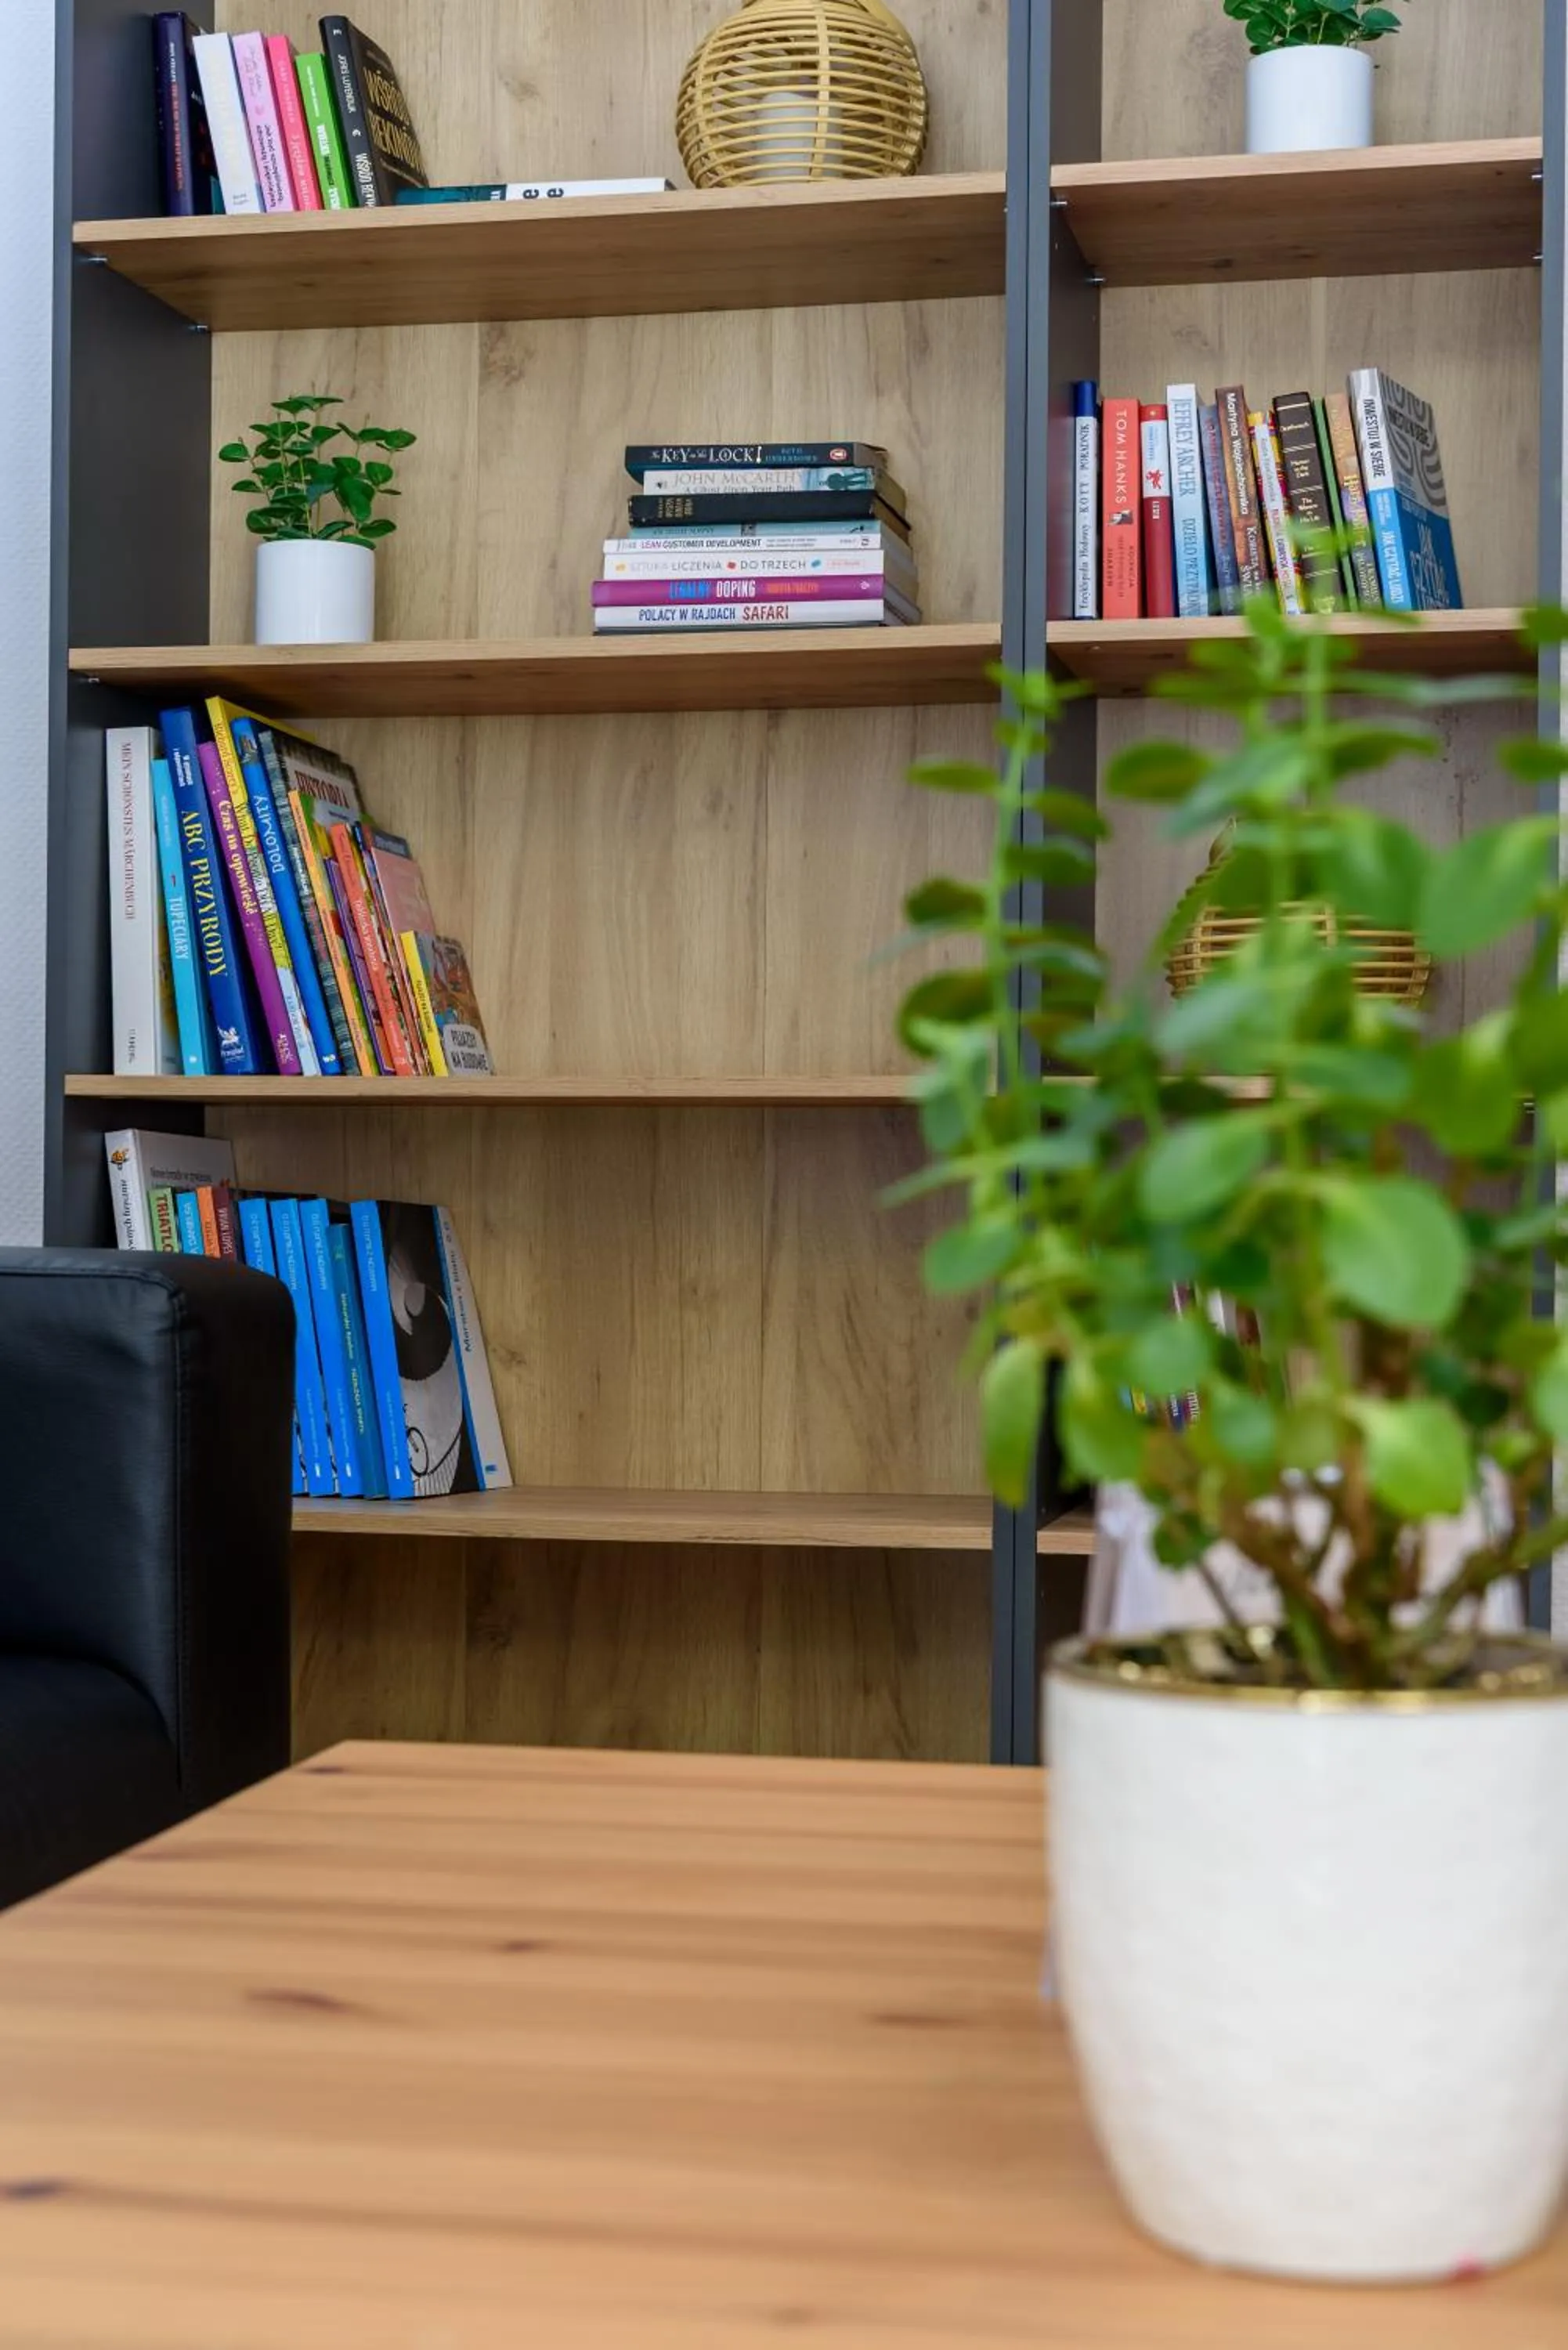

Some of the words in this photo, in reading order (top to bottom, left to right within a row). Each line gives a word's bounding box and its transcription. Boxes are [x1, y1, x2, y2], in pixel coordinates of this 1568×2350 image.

[1115, 408, 1128, 444] TOM
[1169, 397, 1194, 446] JEFFREY
[1225, 392, 1240, 436] Martyna
[1361, 398, 1380, 440] INWESTUJ
[660, 446, 692, 464] KEY
[709, 446, 756, 463] LOCK
[1079, 423, 1089, 471] PORADNIK
[1367, 440, 1383, 450] W
[674, 472, 714, 486] JOHN
[1114, 450, 1128, 504] HANKS
[1175, 445, 1198, 497] ARCHER
[1370, 450, 1386, 477] SIEBIE
[1078, 481, 1089, 513] KOTY
[662, 539, 704, 550] CUSTOMER
[705, 537, 762, 548] DEVELOPMENT
[671, 560, 721, 571] LICZENIA
[739, 559, 758, 569] DO
[761, 559, 805, 569] TRZECH
[715, 579, 756, 598] DOPING
[638, 608, 676, 622] POLACY
[678, 608, 688, 620] W
[691, 607, 735, 620] RAJDACH
[742, 605, 789, 620] SAFARI
[121, 741, 132, 769] MEIN
[121, 772, 135, 835] SCHÖNSTES
[218, 800, 236, 831] Czas
[181, 810, 205, 853] ABC
[226, 834, 237, 848] na
[253, 795, 285, 873] DOLOMITY
[121, 837, 137, 920] MÄRCHENBUCH
[190, 858, 229, 978] PRZYRODY
